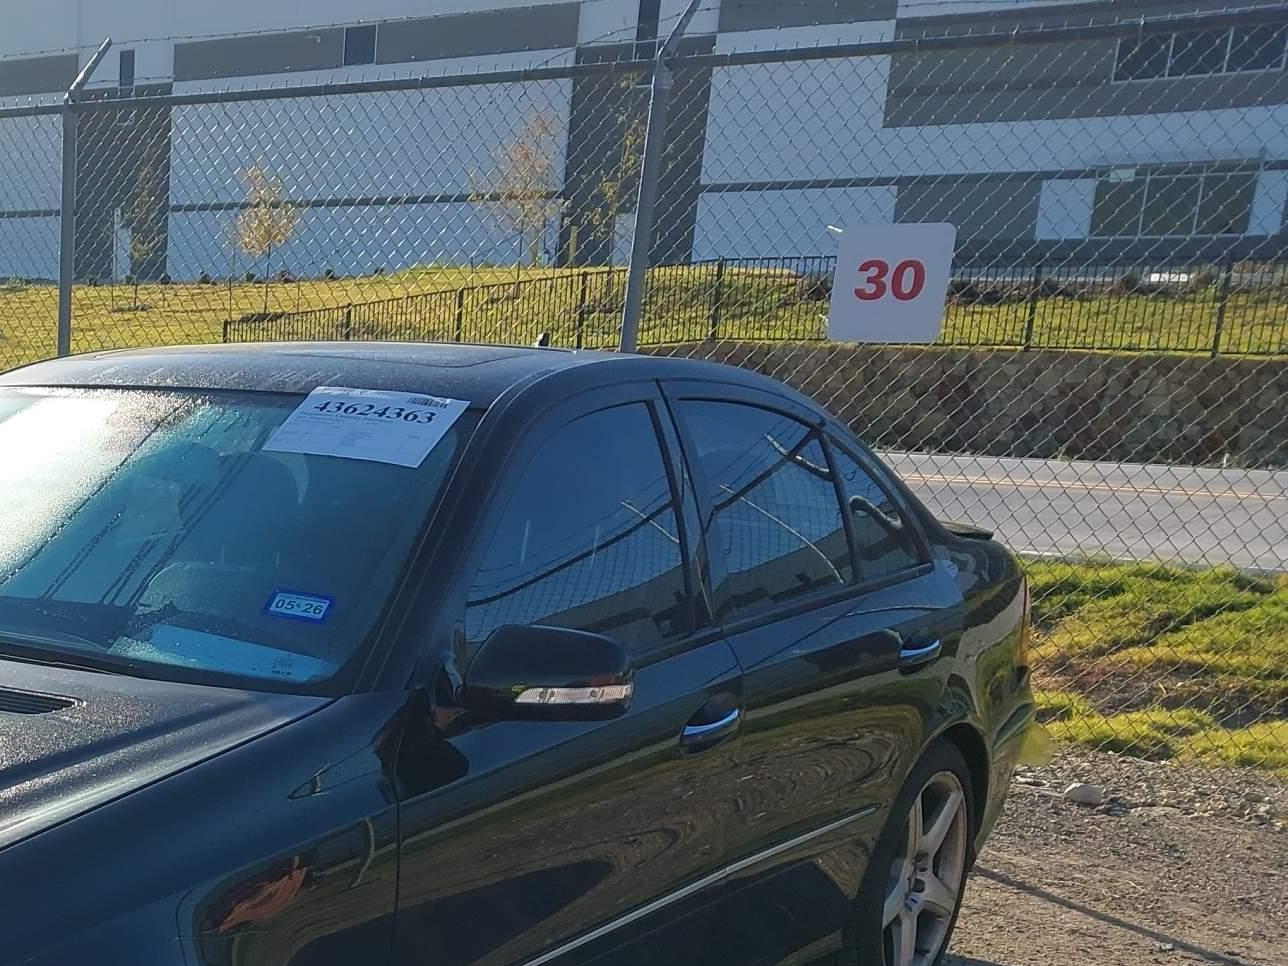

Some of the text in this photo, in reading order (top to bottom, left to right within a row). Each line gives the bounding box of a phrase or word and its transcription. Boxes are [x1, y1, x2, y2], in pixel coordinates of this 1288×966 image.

[854, 259, 926, 301] 30
[314, 400, 437, 424] 43624363
[275, 599, 323, 615] 05 26
